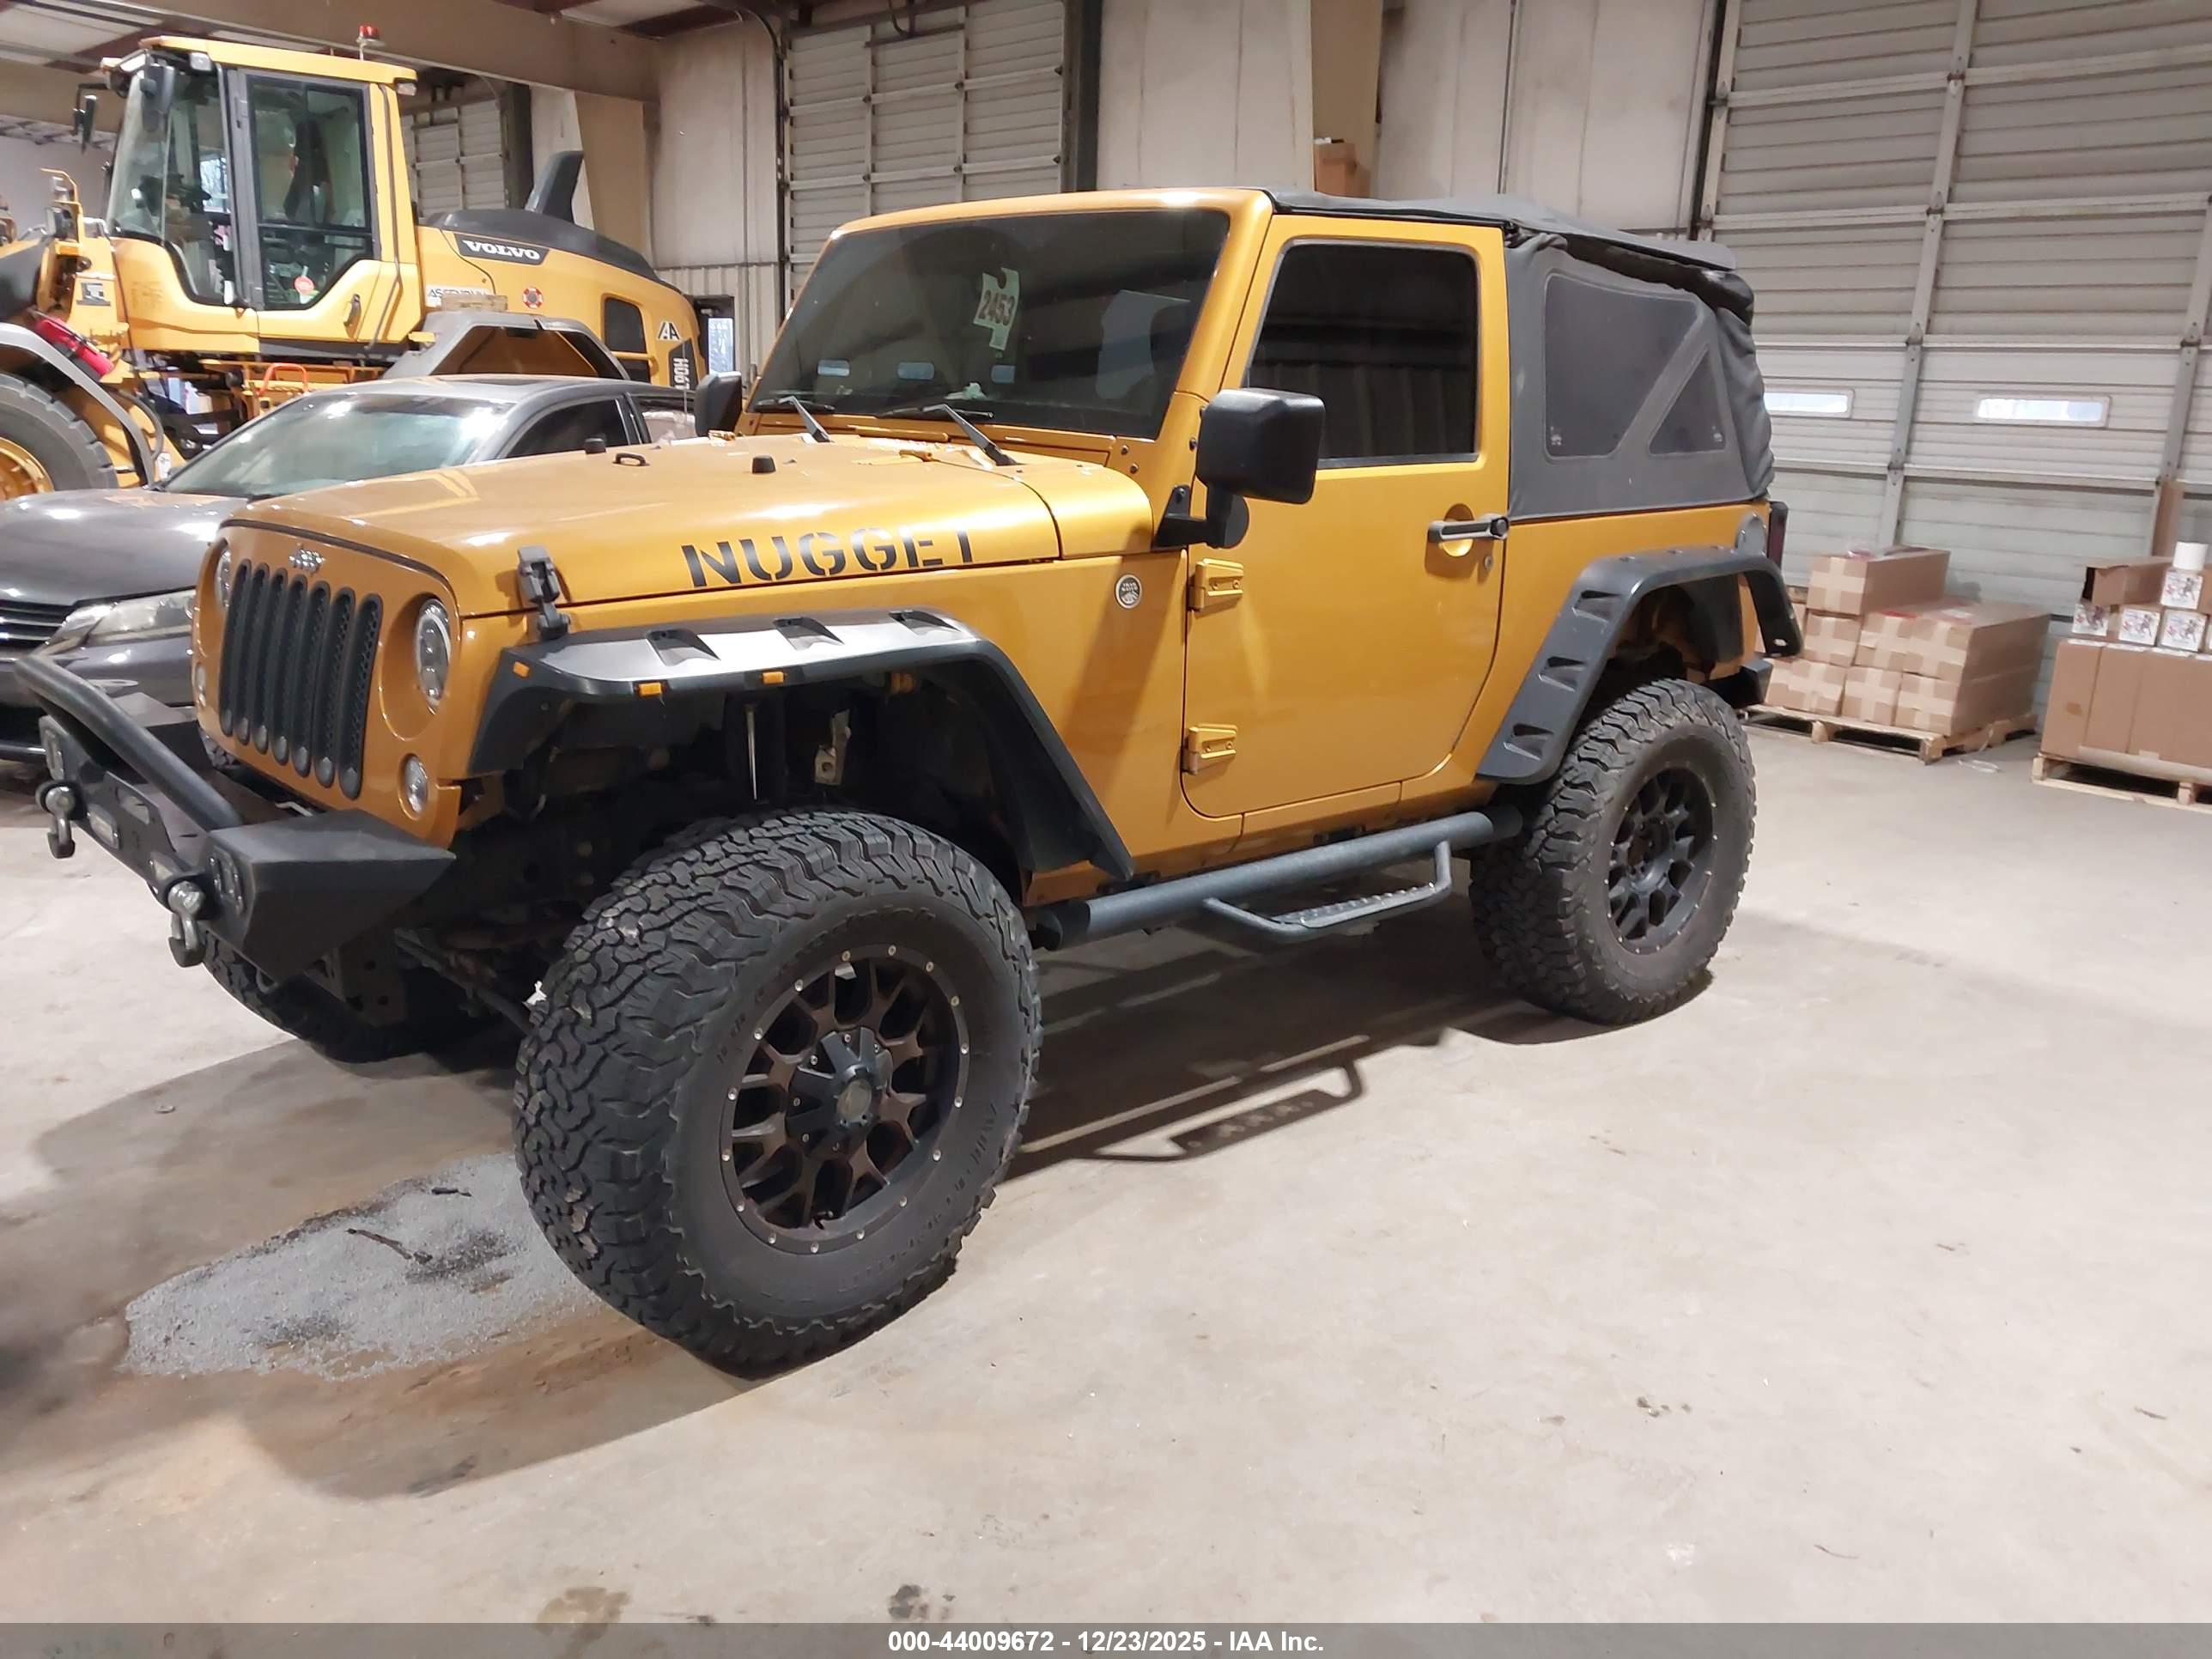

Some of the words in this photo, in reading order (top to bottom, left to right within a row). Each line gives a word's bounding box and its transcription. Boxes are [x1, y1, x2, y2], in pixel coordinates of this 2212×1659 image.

[462, 240, 540, 260] VOLVO
[978, 289, 1016, 326] 2453
[673, 357, 690, 390] L90H
